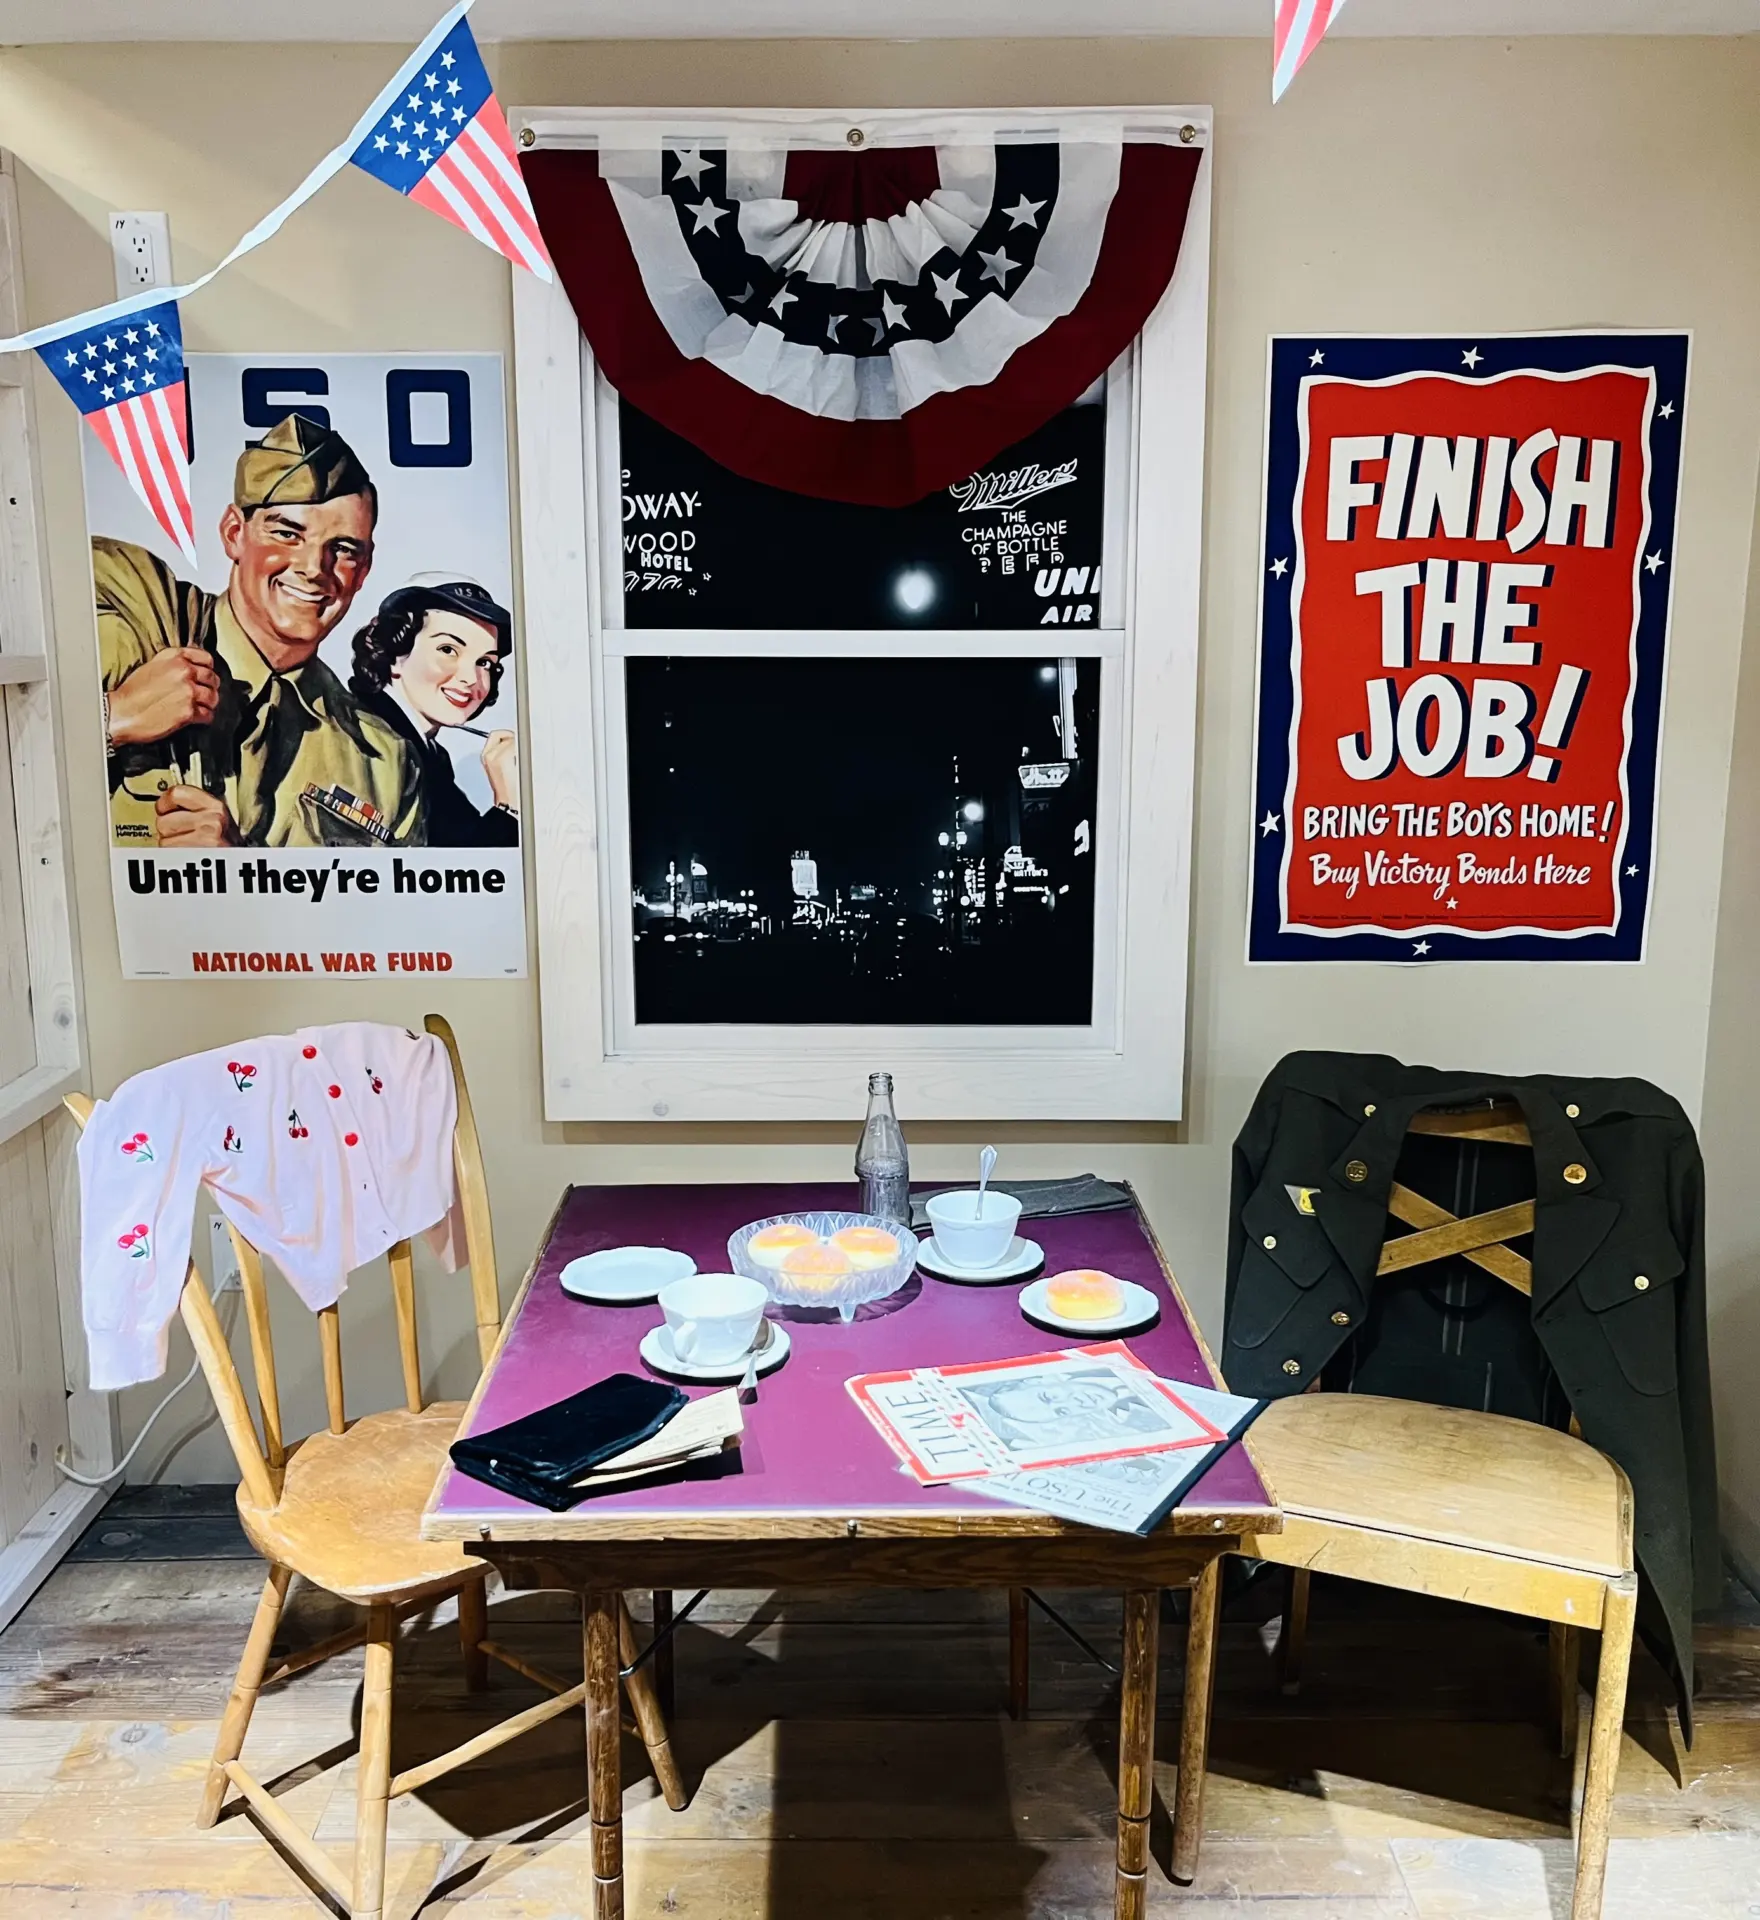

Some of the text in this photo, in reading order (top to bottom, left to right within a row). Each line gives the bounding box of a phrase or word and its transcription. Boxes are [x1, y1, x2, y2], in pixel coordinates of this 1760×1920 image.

[1326, 428, 1618, 554] FINISH
[961, 520, 1067, 542] CHAMPAGNE
[1001, 510, 1027, 524] THE
[640, 551, 693, 573] HOTEL
[971, 536, 1059, 556] OF BOTTLE
[1040, 604, 1093, 625] AIR
[1355, 557, 1550, 667] THE
[1337, 664, 1586, 782] JOB!
[1303, 804, 1391, 841] BRING
[1392, 803, 1441, 838] THE
[1446, 801, 1512, 839] BOYS
[127, 858, 506, 903] Until they're home
[1308, 849, 1591, 901] Buy Victory Bonds Here
[192, 951, 453, 973] NATIONAL WAR FUND
[885, 1391, 969, 1464] TIME
[1027, 1477, 1087, 1501] USO
